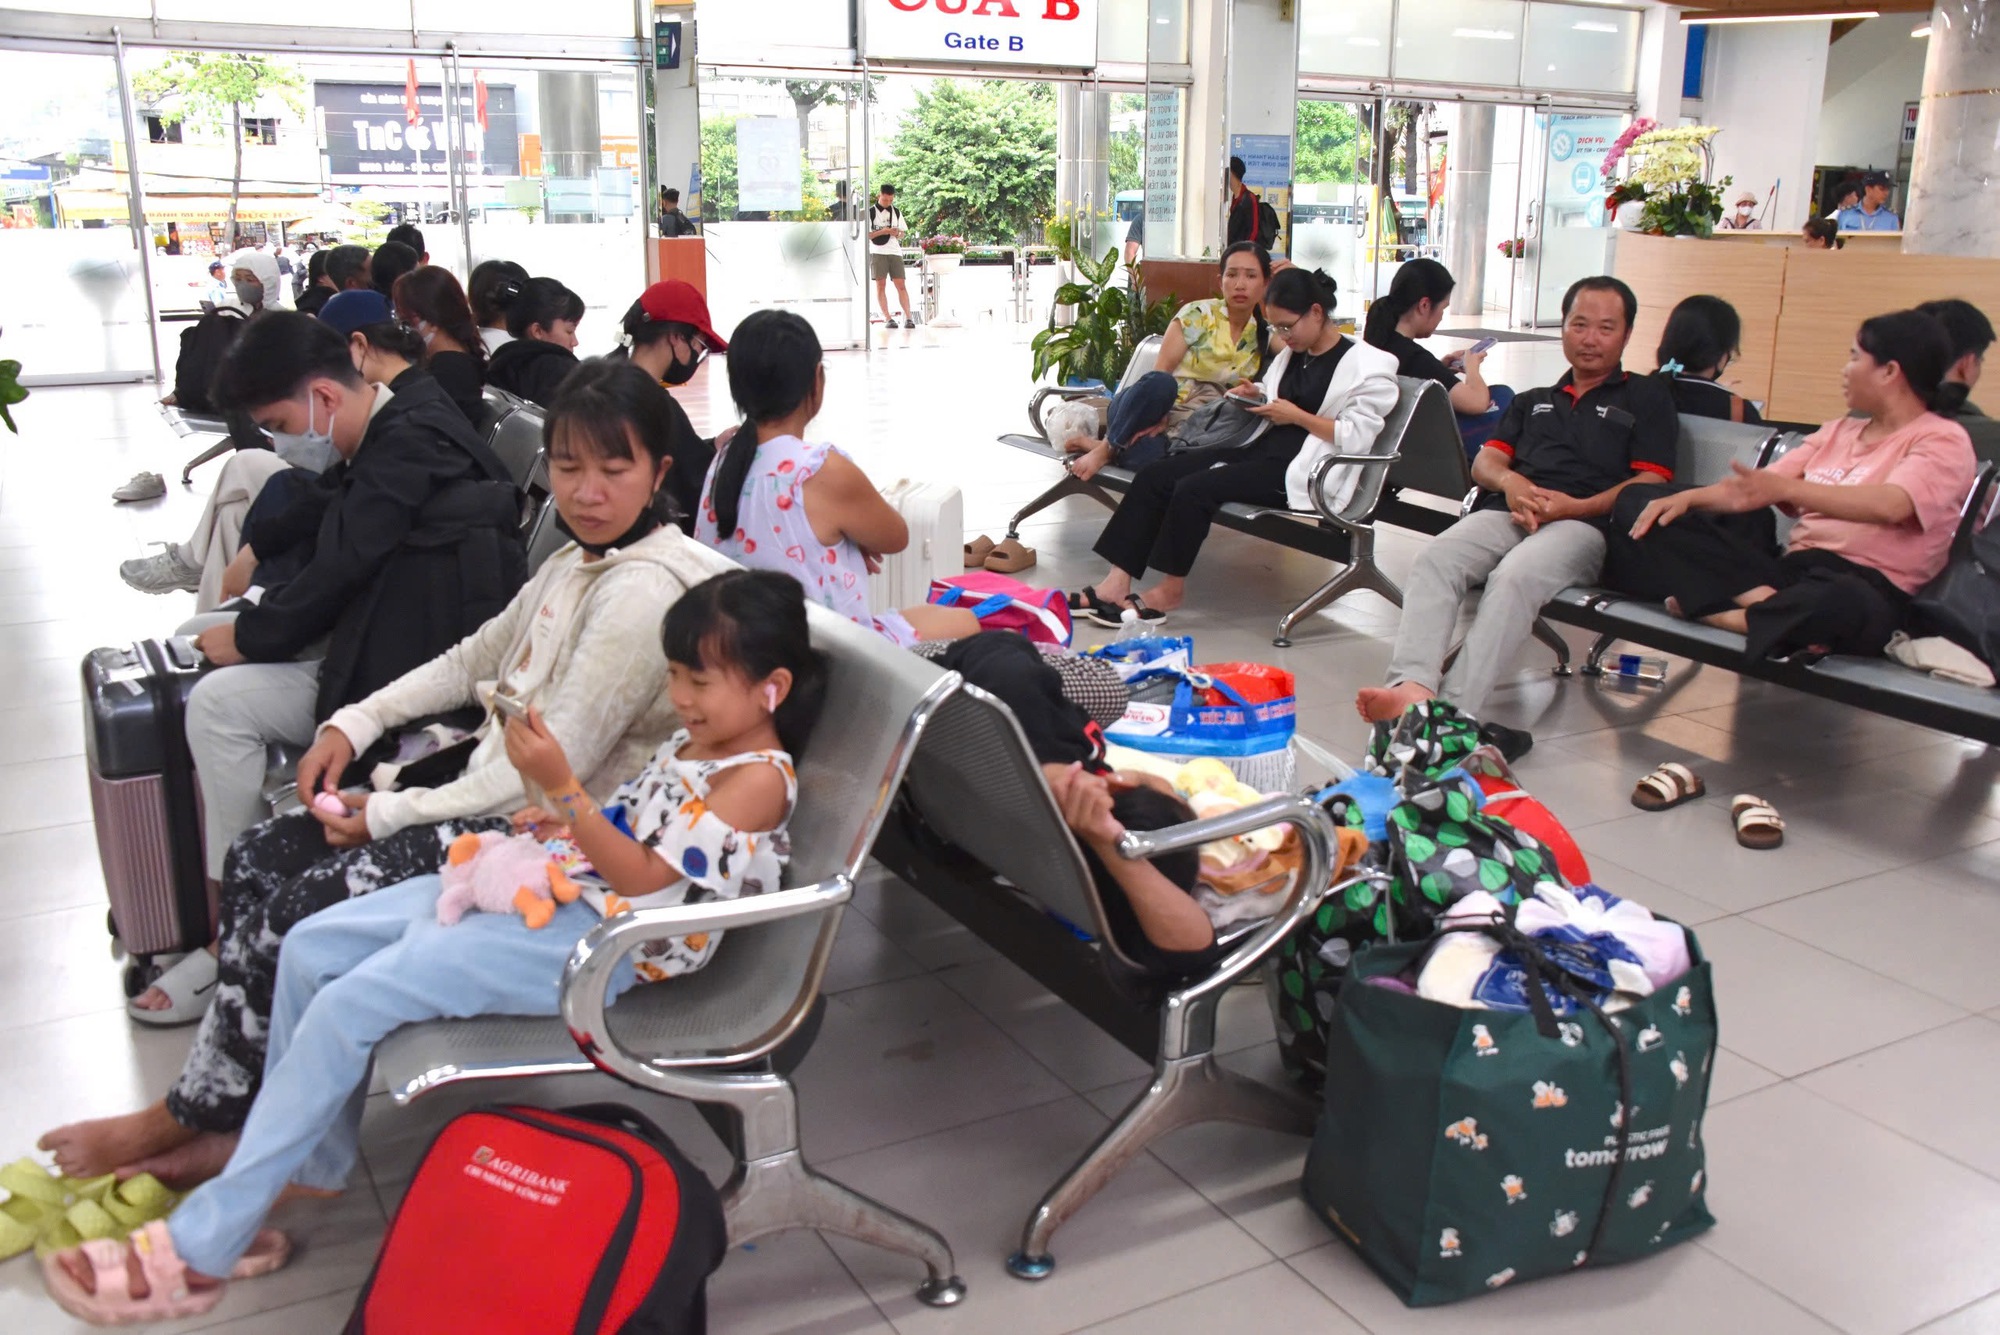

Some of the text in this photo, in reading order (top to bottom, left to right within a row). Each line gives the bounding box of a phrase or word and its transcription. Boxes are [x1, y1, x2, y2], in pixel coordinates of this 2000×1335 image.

[944, 32, 1024, 51] Gate B
[488, 1157, 571, 1194] AGRIBANK
